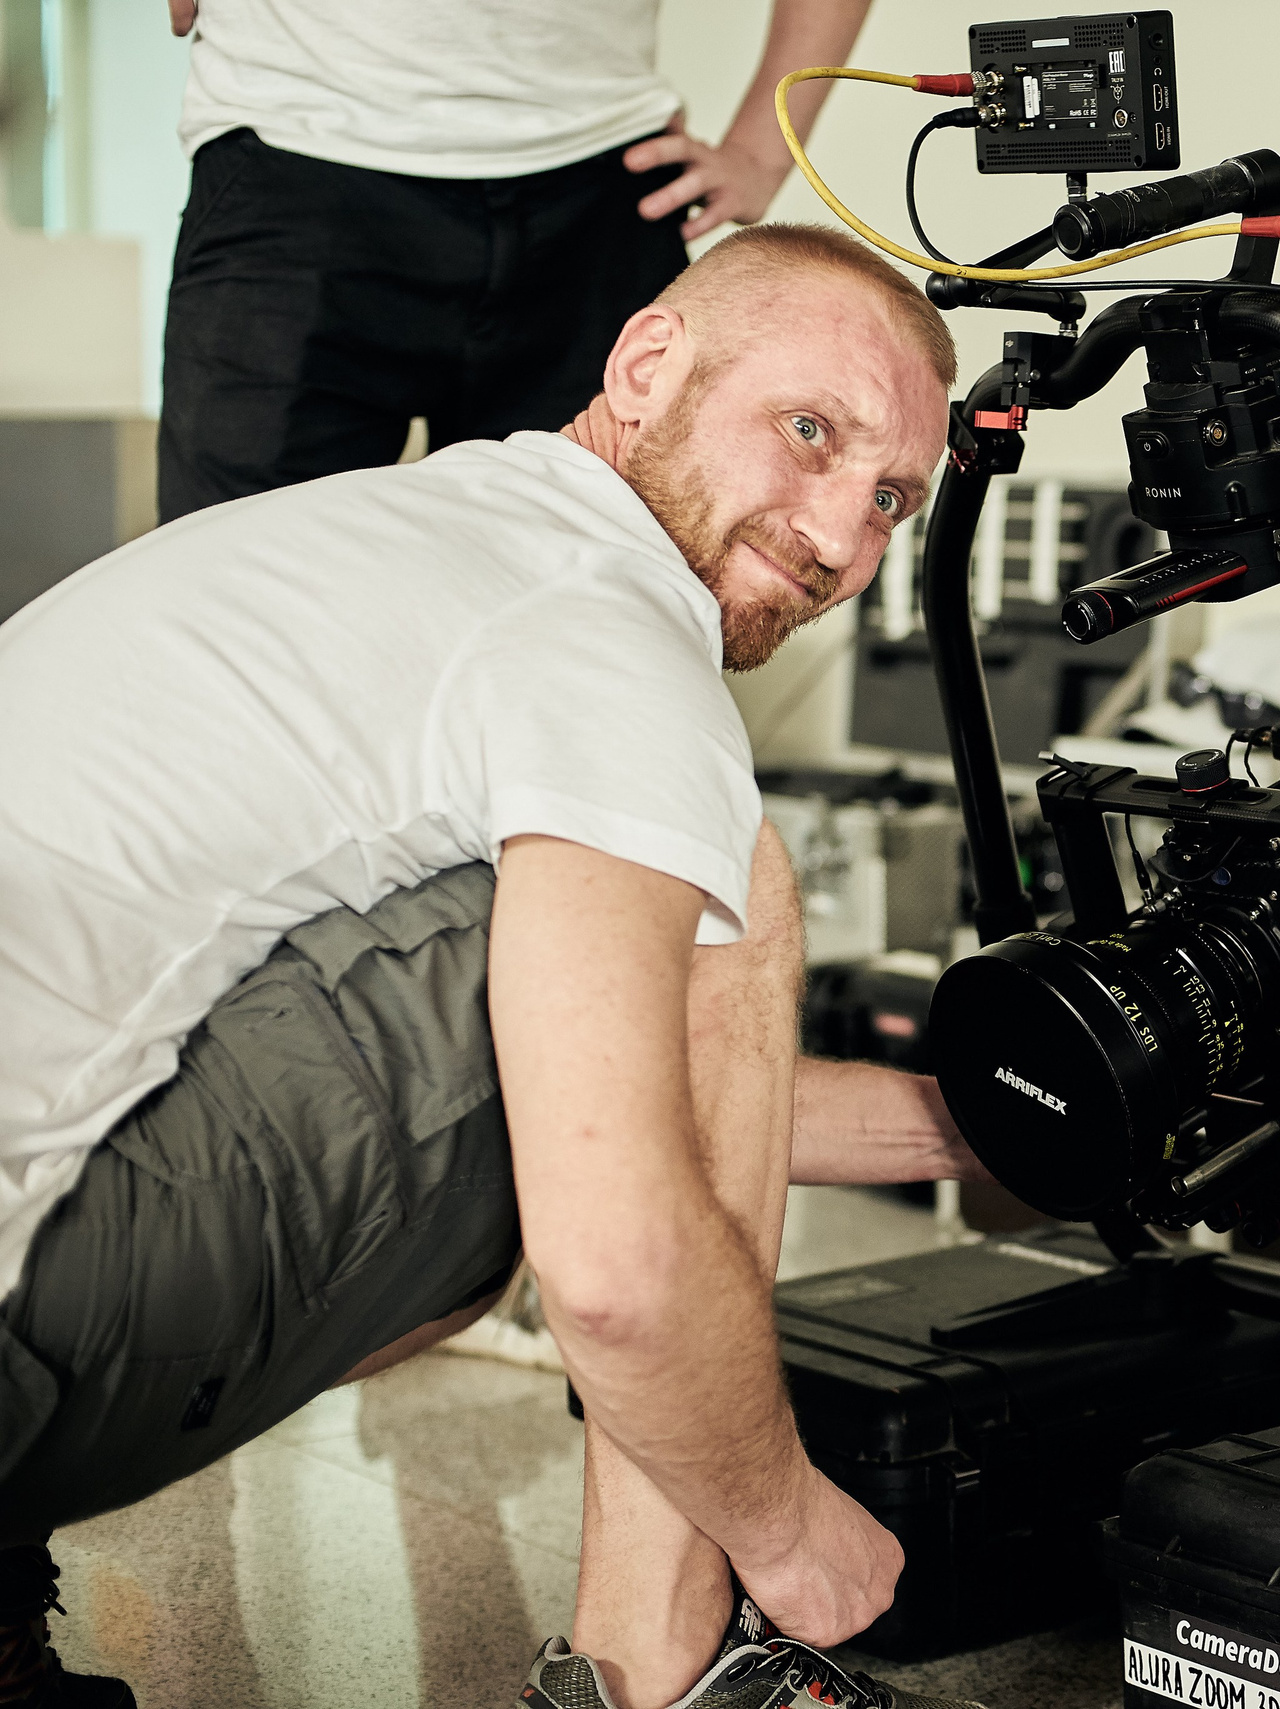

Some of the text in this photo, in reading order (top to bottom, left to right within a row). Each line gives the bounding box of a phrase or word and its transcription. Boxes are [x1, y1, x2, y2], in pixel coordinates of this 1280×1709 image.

[1144, 486, 1182, 499] RONIN
[1109, 985, 1158, 1053] LDS 12 UP
[994, 1066, 1067, 1115] ARRIFLEX
[1128, 1646, 1245, 1709] ALURA ZOOM
